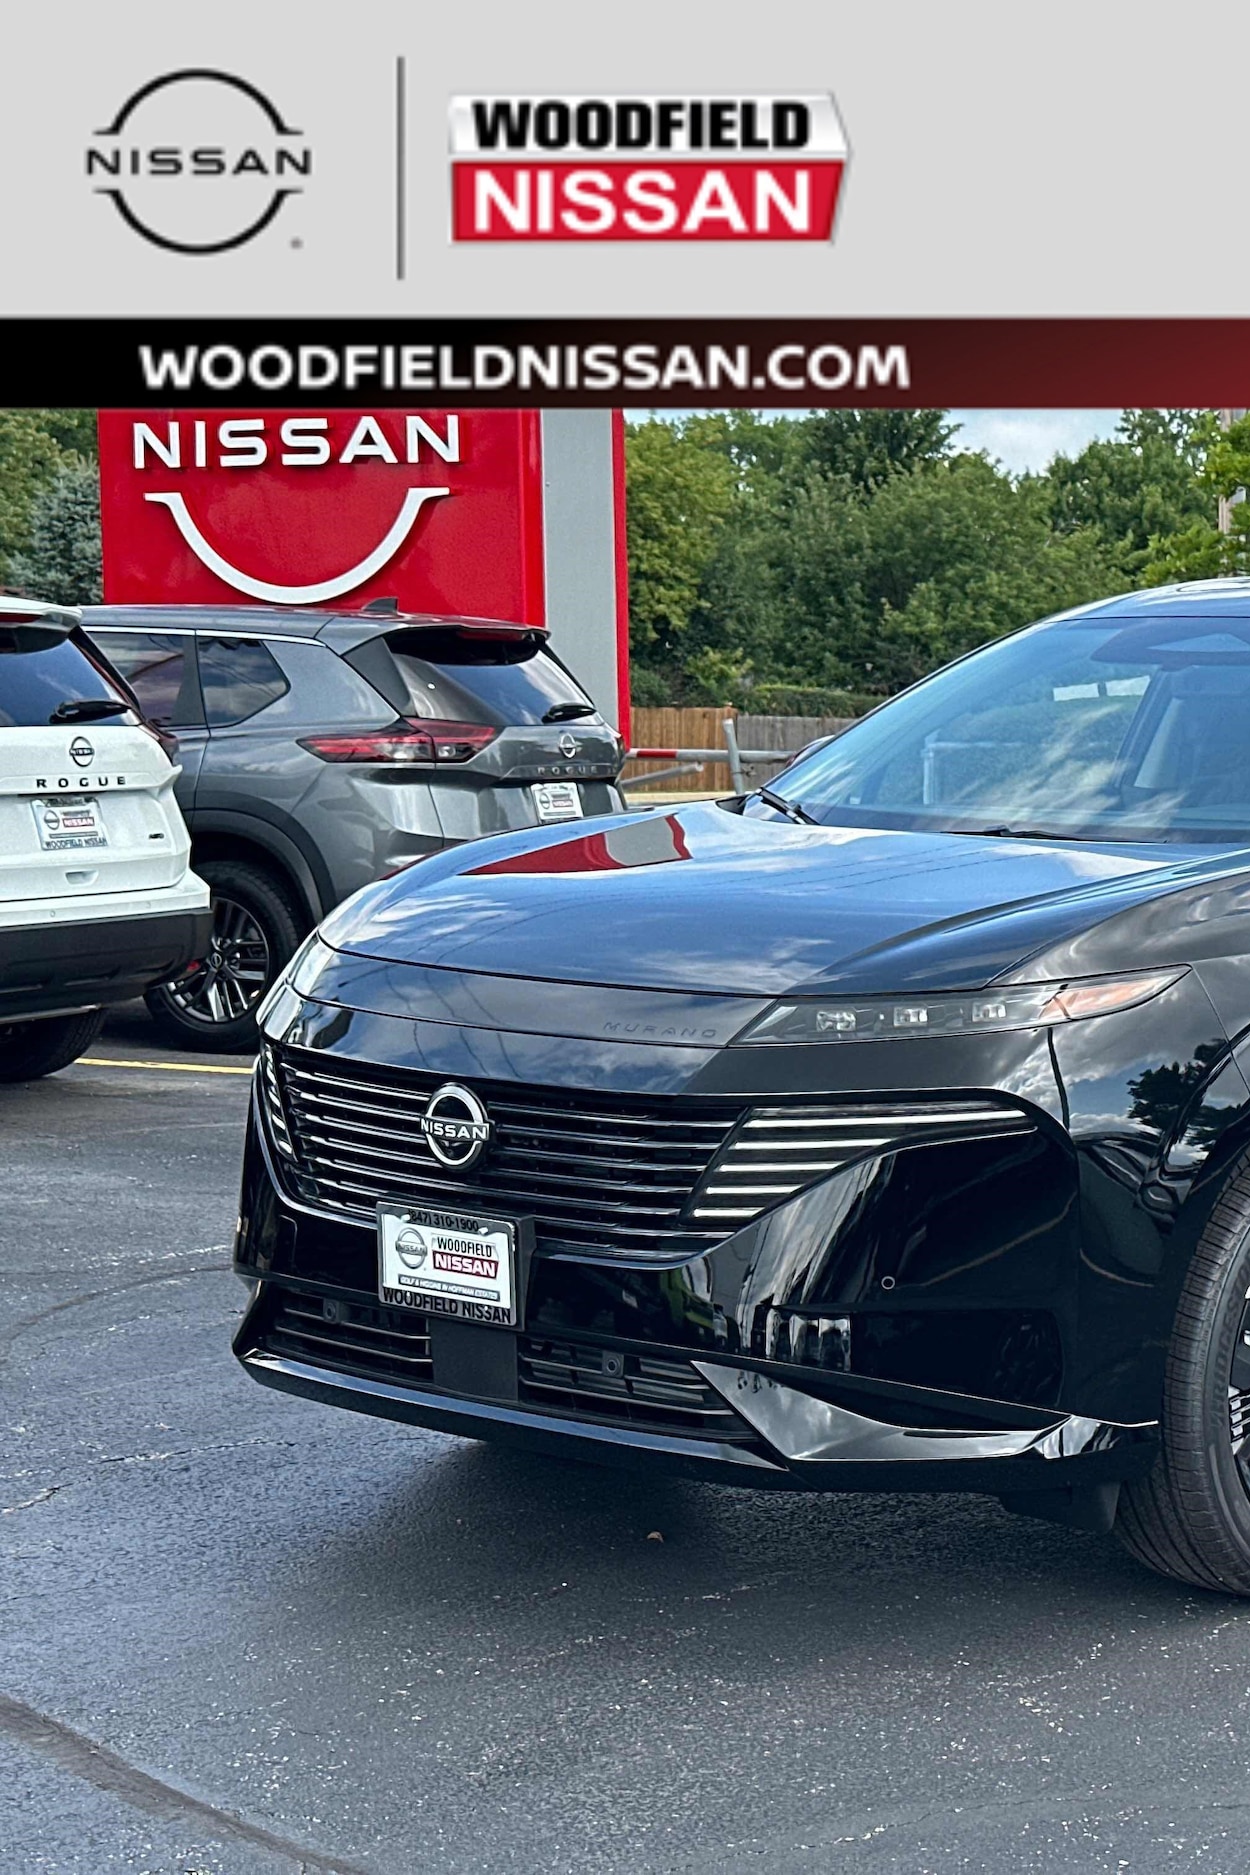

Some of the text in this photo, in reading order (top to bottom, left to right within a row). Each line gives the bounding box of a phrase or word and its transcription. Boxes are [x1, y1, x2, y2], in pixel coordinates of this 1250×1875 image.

[133, 414, 460, 469] NISSAN
[537, 766, 598, 775] ROGUE
[36, 776, 126, 788] ROGUE
[420, 1119, 488, 1139] NISSAN
[433, 1214, 480, 1232] 310-1900
[437, 1236, 493, 1258] WOODFIELD
[434, 1252, 496, 1278] NISSAN
[383, 1288, 511, 1325] WOODFIELD NISSAN
